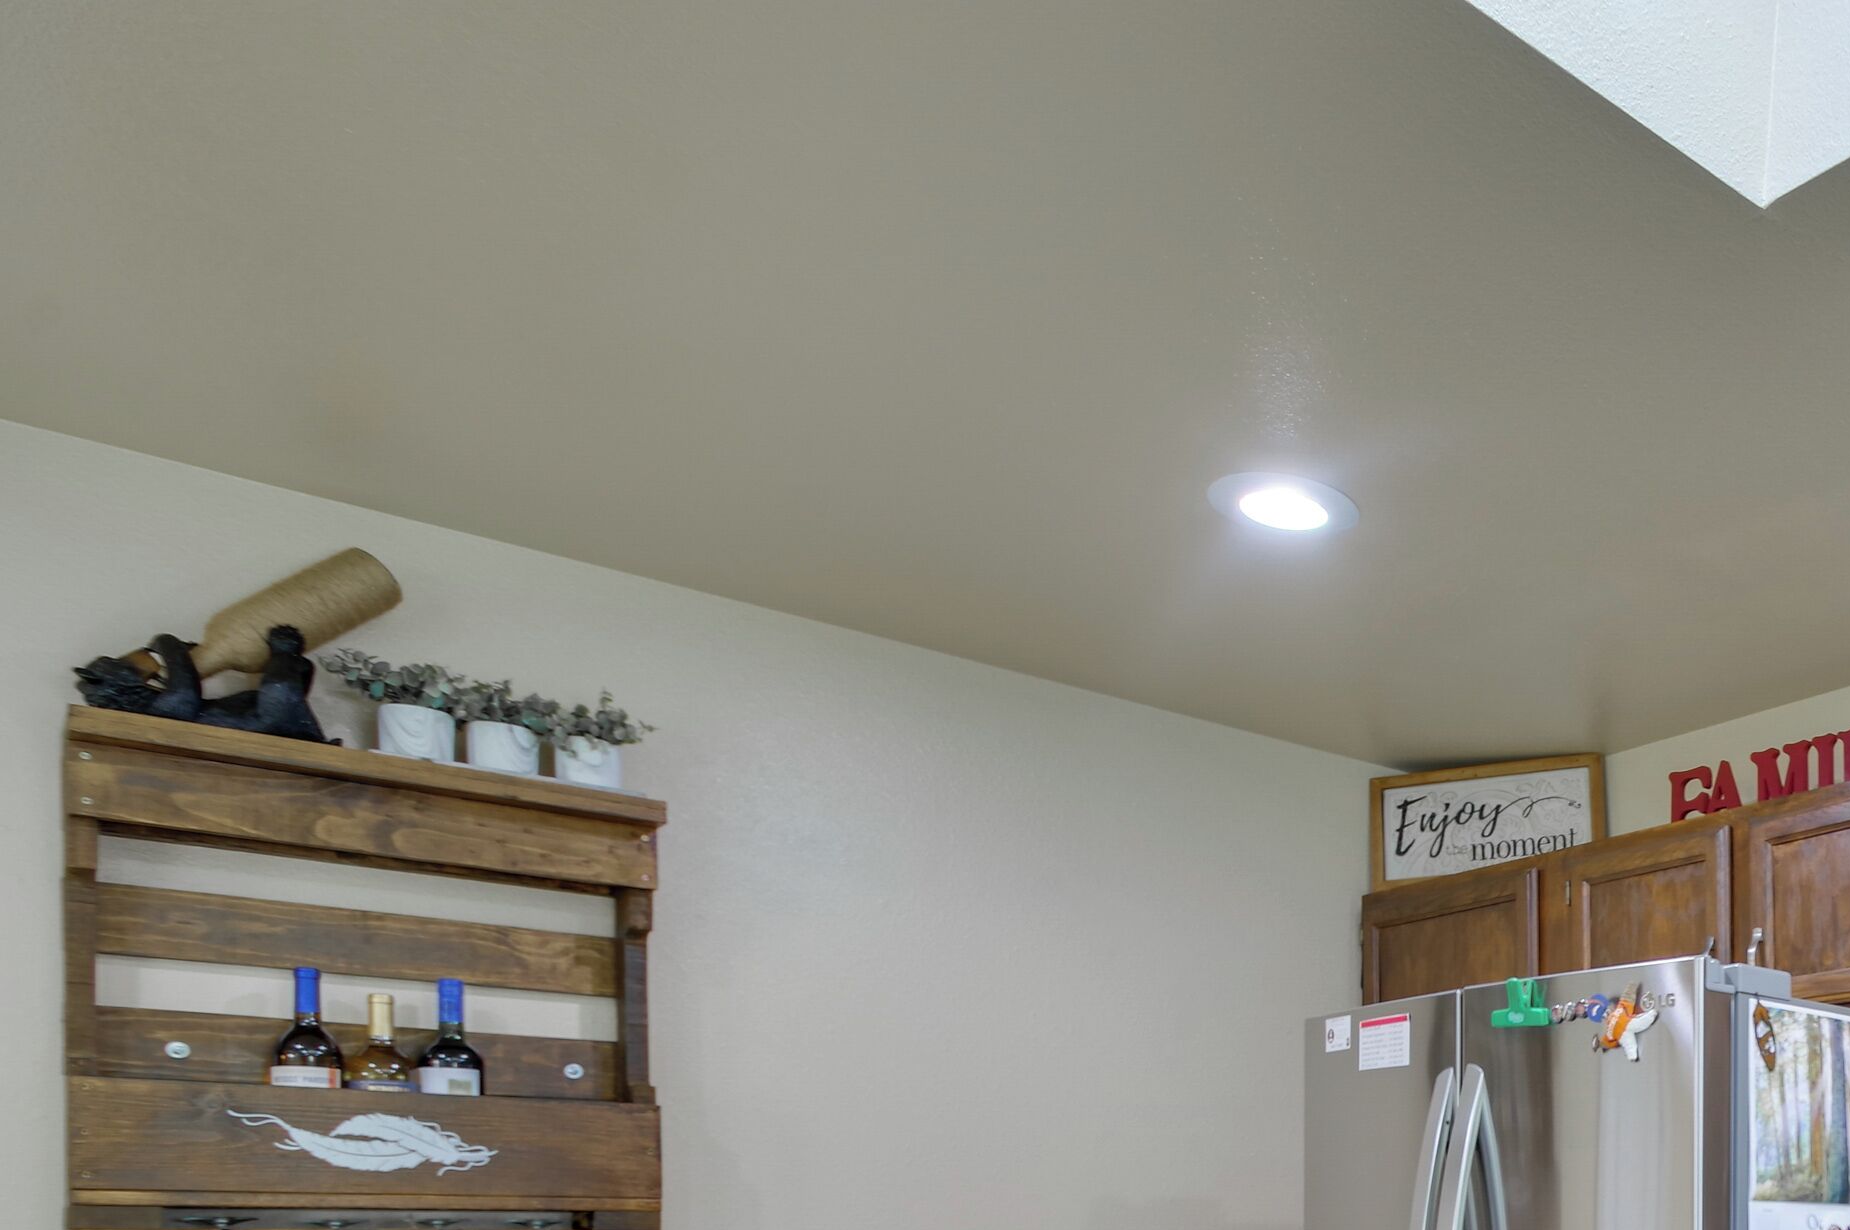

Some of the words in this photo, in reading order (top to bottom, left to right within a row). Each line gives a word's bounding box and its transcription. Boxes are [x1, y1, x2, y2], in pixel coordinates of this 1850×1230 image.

[1394, 796, 1535, 858] Enjoy
[1471, 828, 1578, 861] moment
[1658, 993, 1675, 1007] LG
